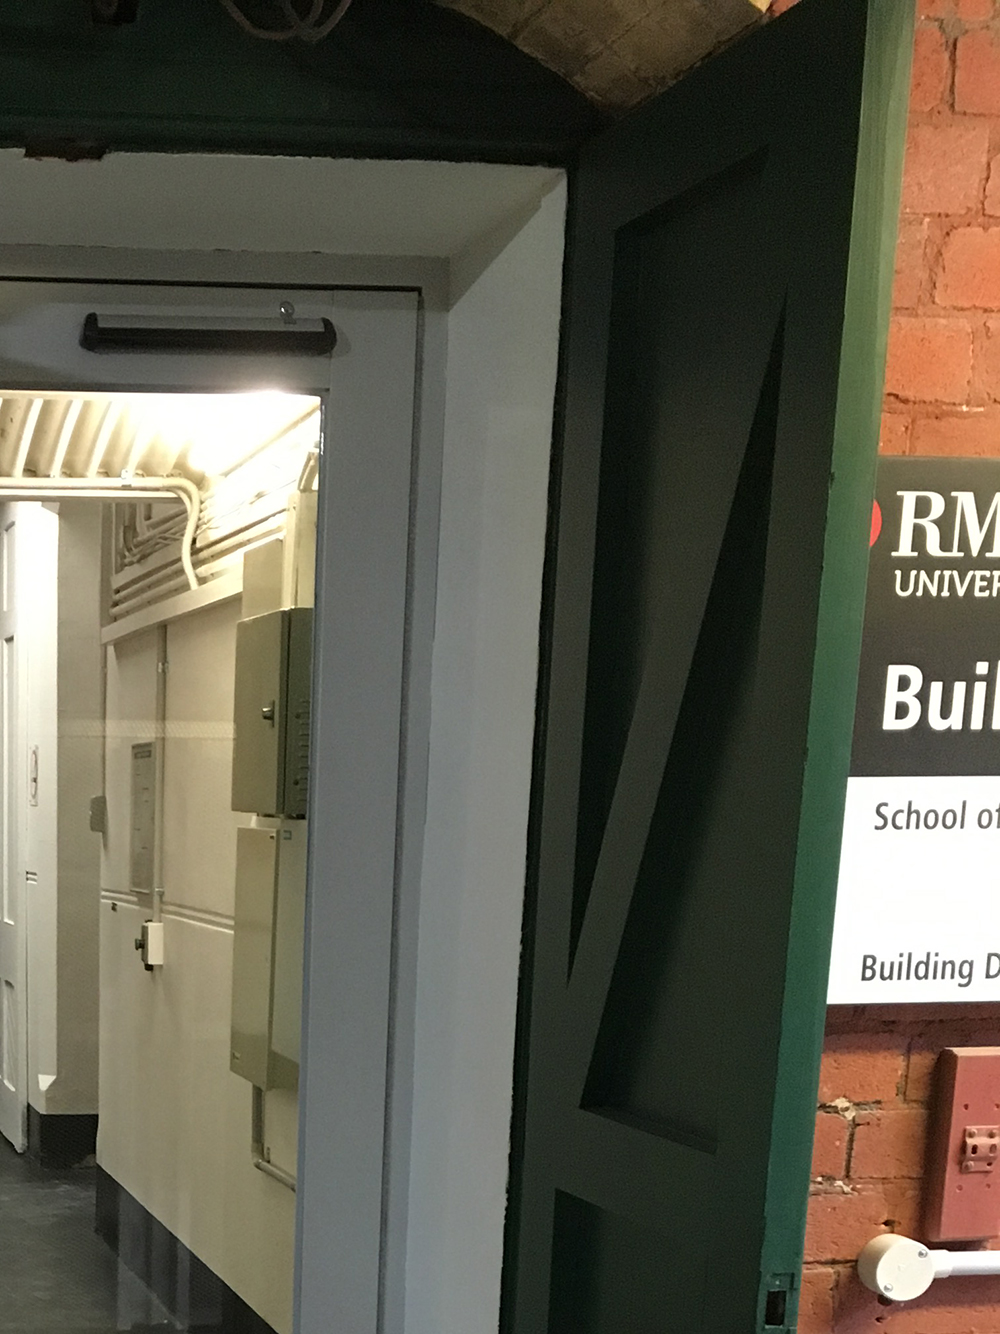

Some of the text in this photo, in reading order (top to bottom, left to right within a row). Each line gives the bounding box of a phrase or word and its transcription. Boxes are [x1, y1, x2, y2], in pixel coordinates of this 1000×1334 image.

[891, 491, 1000, 557] RM
[874, 800, 967, 830] School
[861, 951, 974, 987] Building
